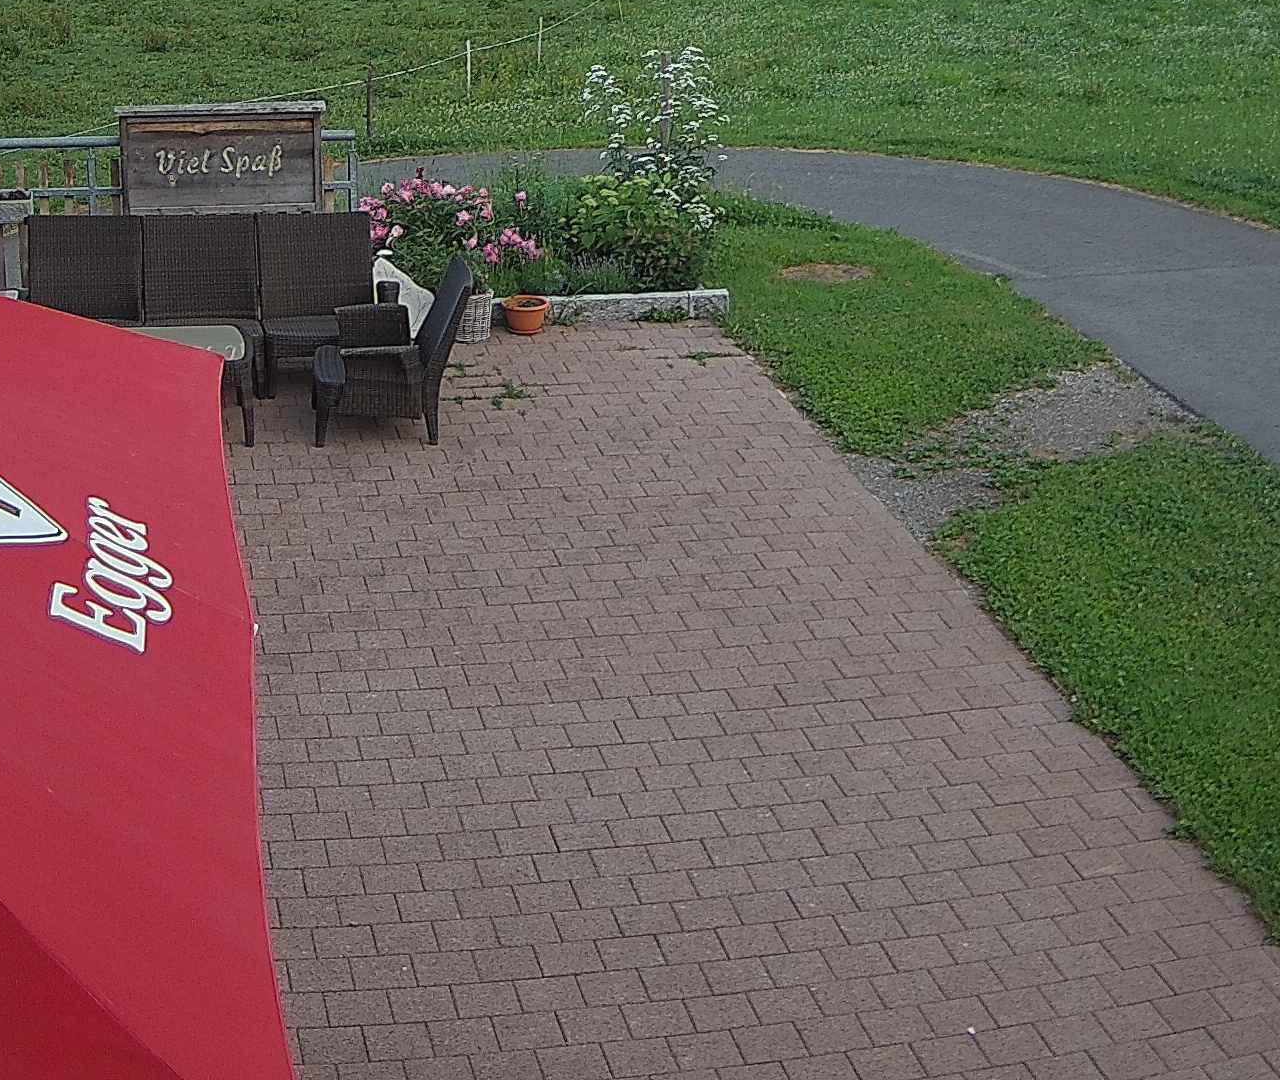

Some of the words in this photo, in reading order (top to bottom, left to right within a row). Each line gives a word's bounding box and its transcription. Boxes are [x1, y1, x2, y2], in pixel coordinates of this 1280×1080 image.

[155, 149, 212, 175] Viel
[219, 144, 283, 179] Spaß
[49, 495, 173, 654] Egger
